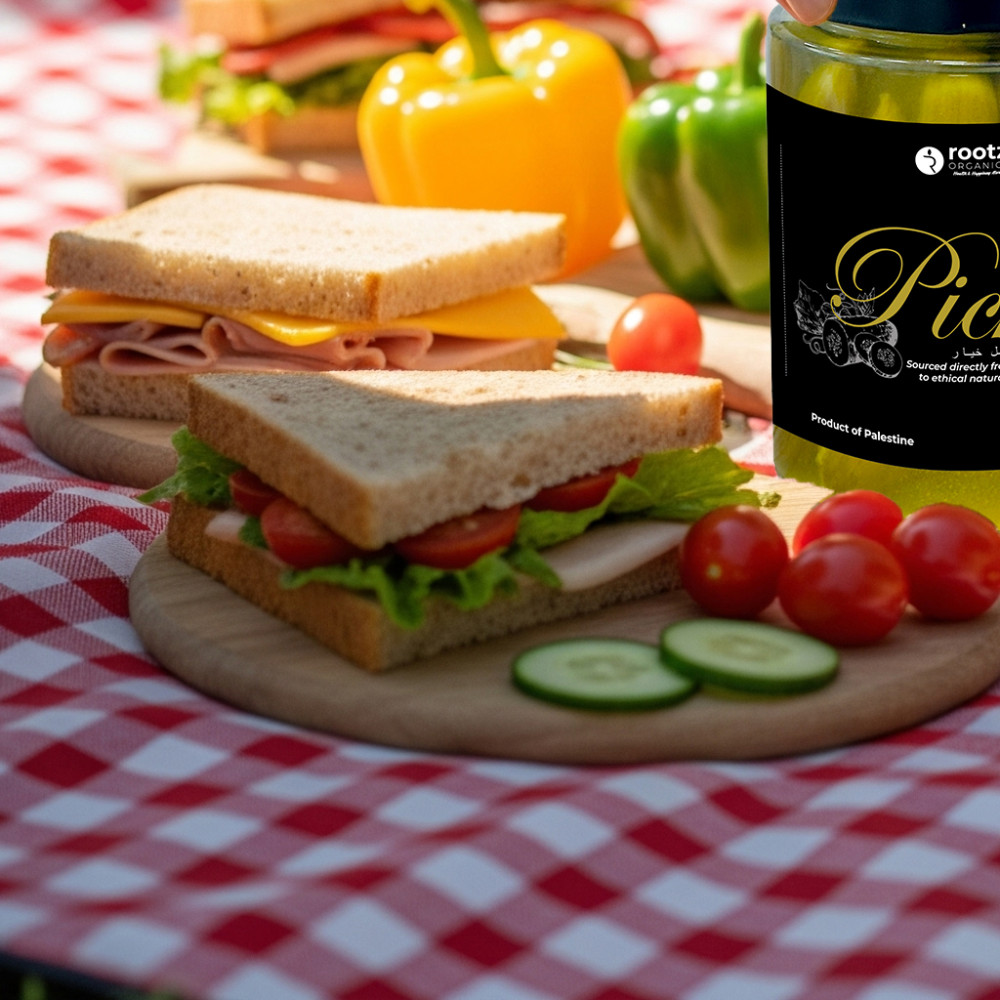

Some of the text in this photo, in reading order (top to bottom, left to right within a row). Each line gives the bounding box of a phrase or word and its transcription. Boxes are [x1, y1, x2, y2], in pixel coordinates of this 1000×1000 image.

[906, 359, 948, 371] Sourced
[949, 362, 989, 373] directly
[919, 373, 930, 382] to
[931, 374, 968, 383] ethical
[811, 412, 915, 447] Product of Palestine
